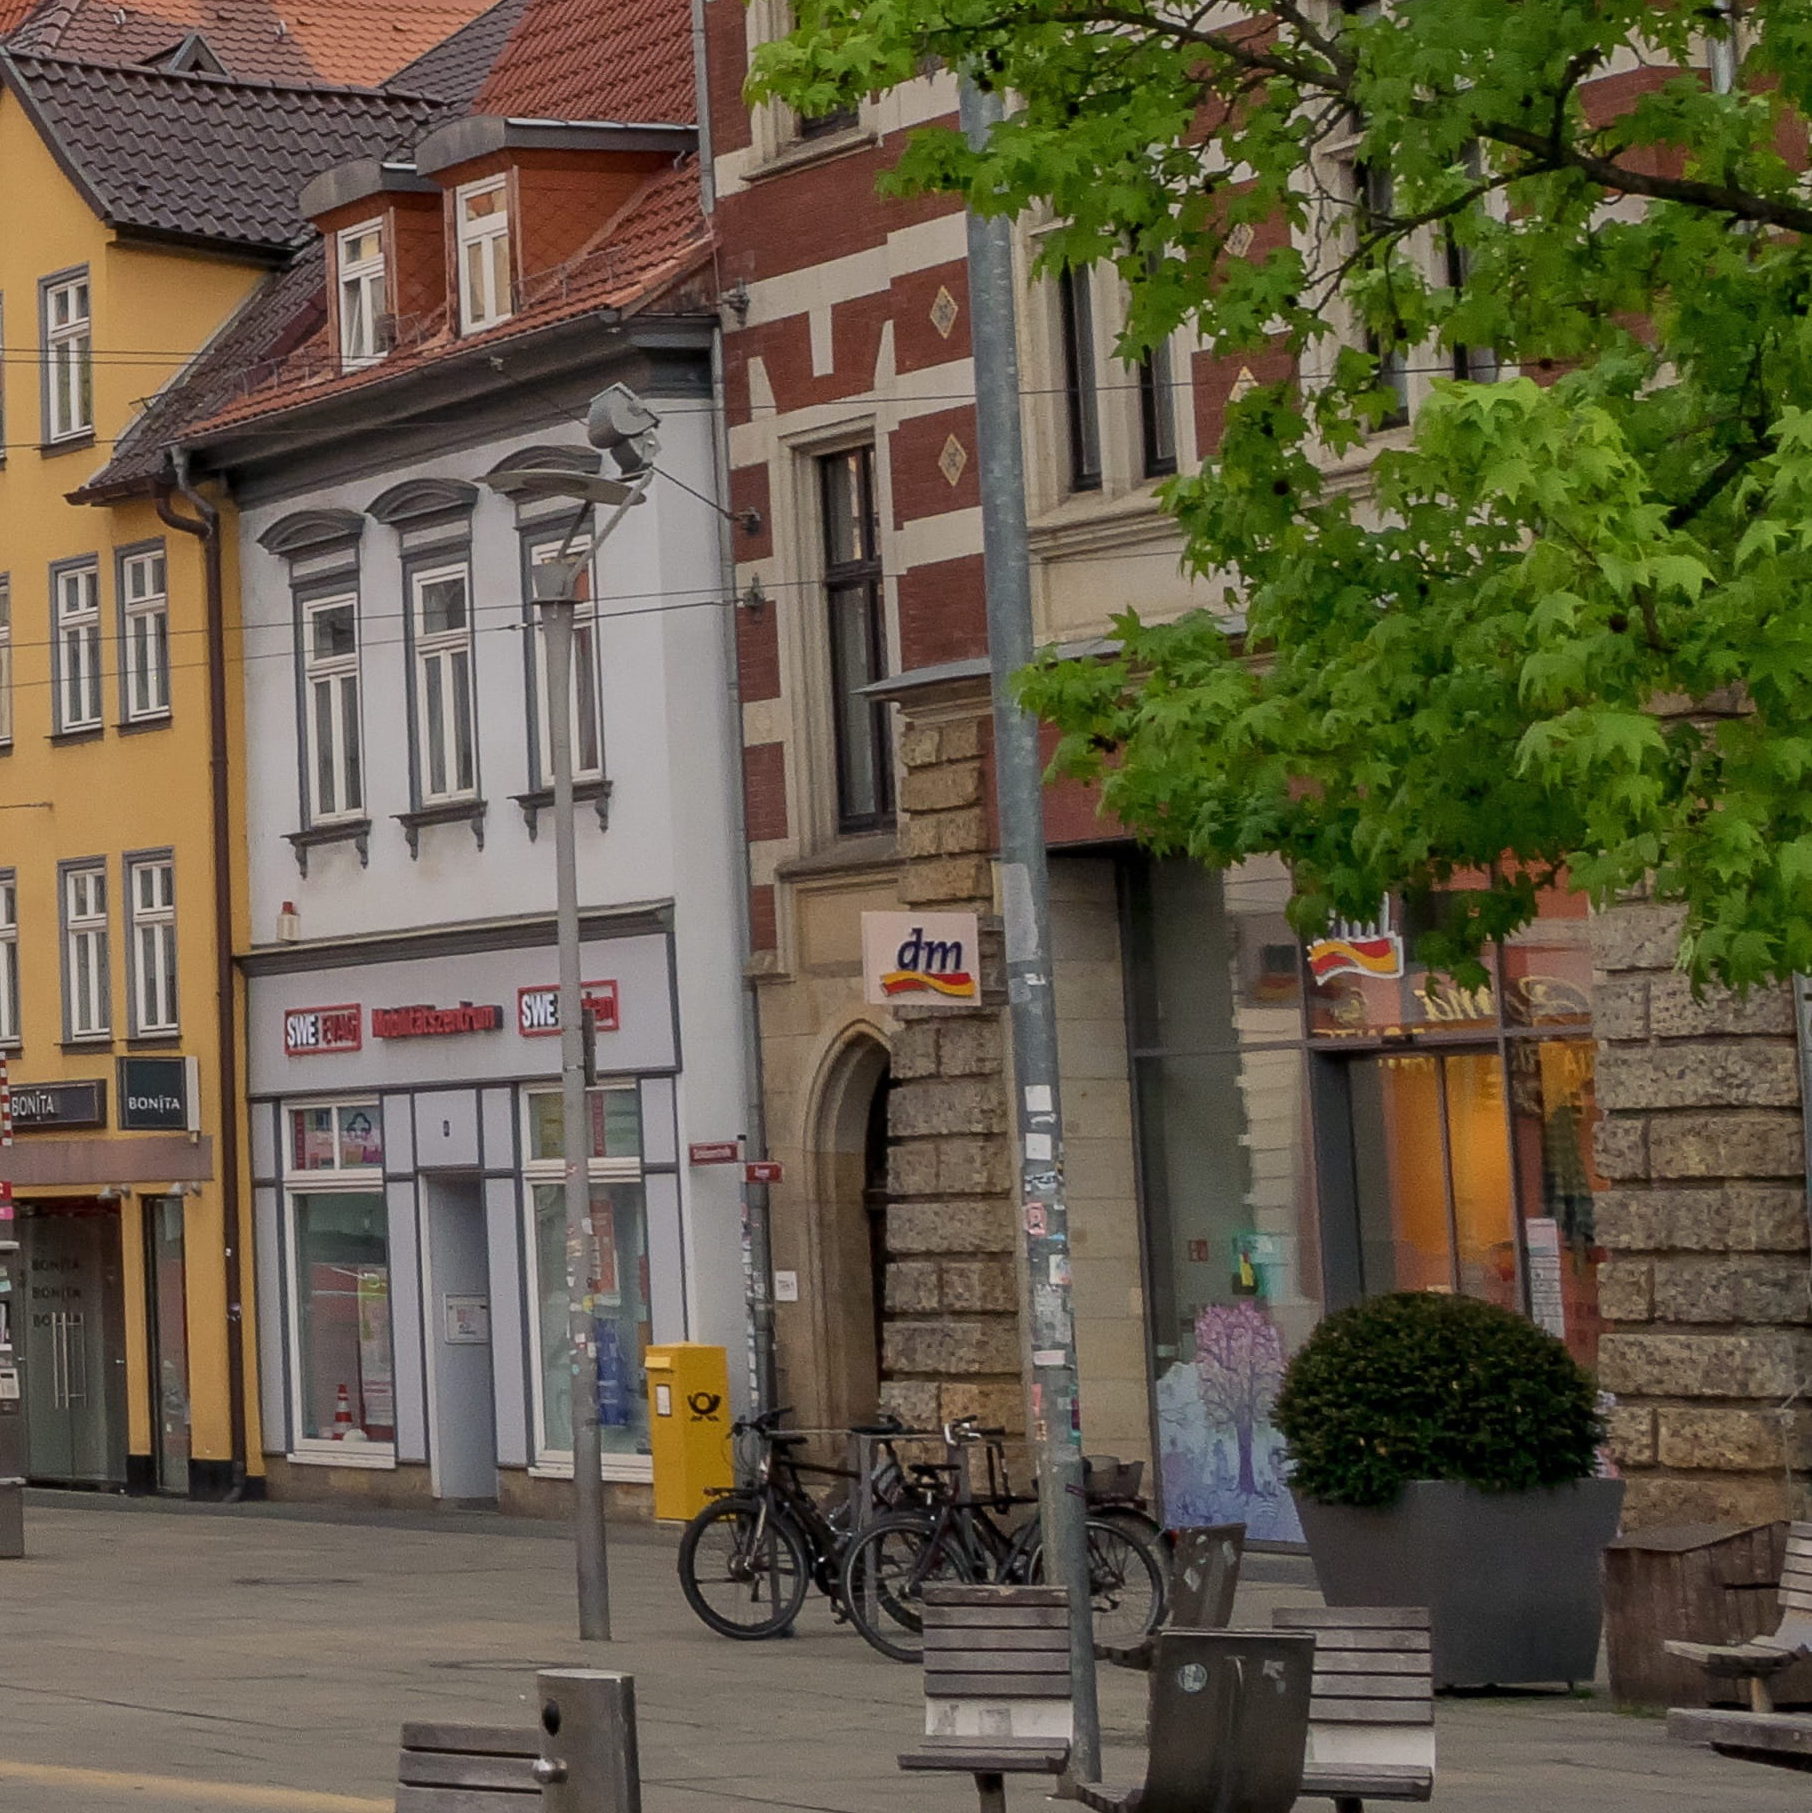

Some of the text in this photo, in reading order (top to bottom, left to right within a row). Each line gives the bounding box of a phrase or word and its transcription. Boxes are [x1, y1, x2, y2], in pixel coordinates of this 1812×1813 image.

[896, 927, 963, 971] dm
[521, 992, 557, 1029] SWE
[287, 1014, 319, 1048] SWE
[11, 1090, 56, 1120] BONITA
[127, 1094, 181, 1114] BONITA
